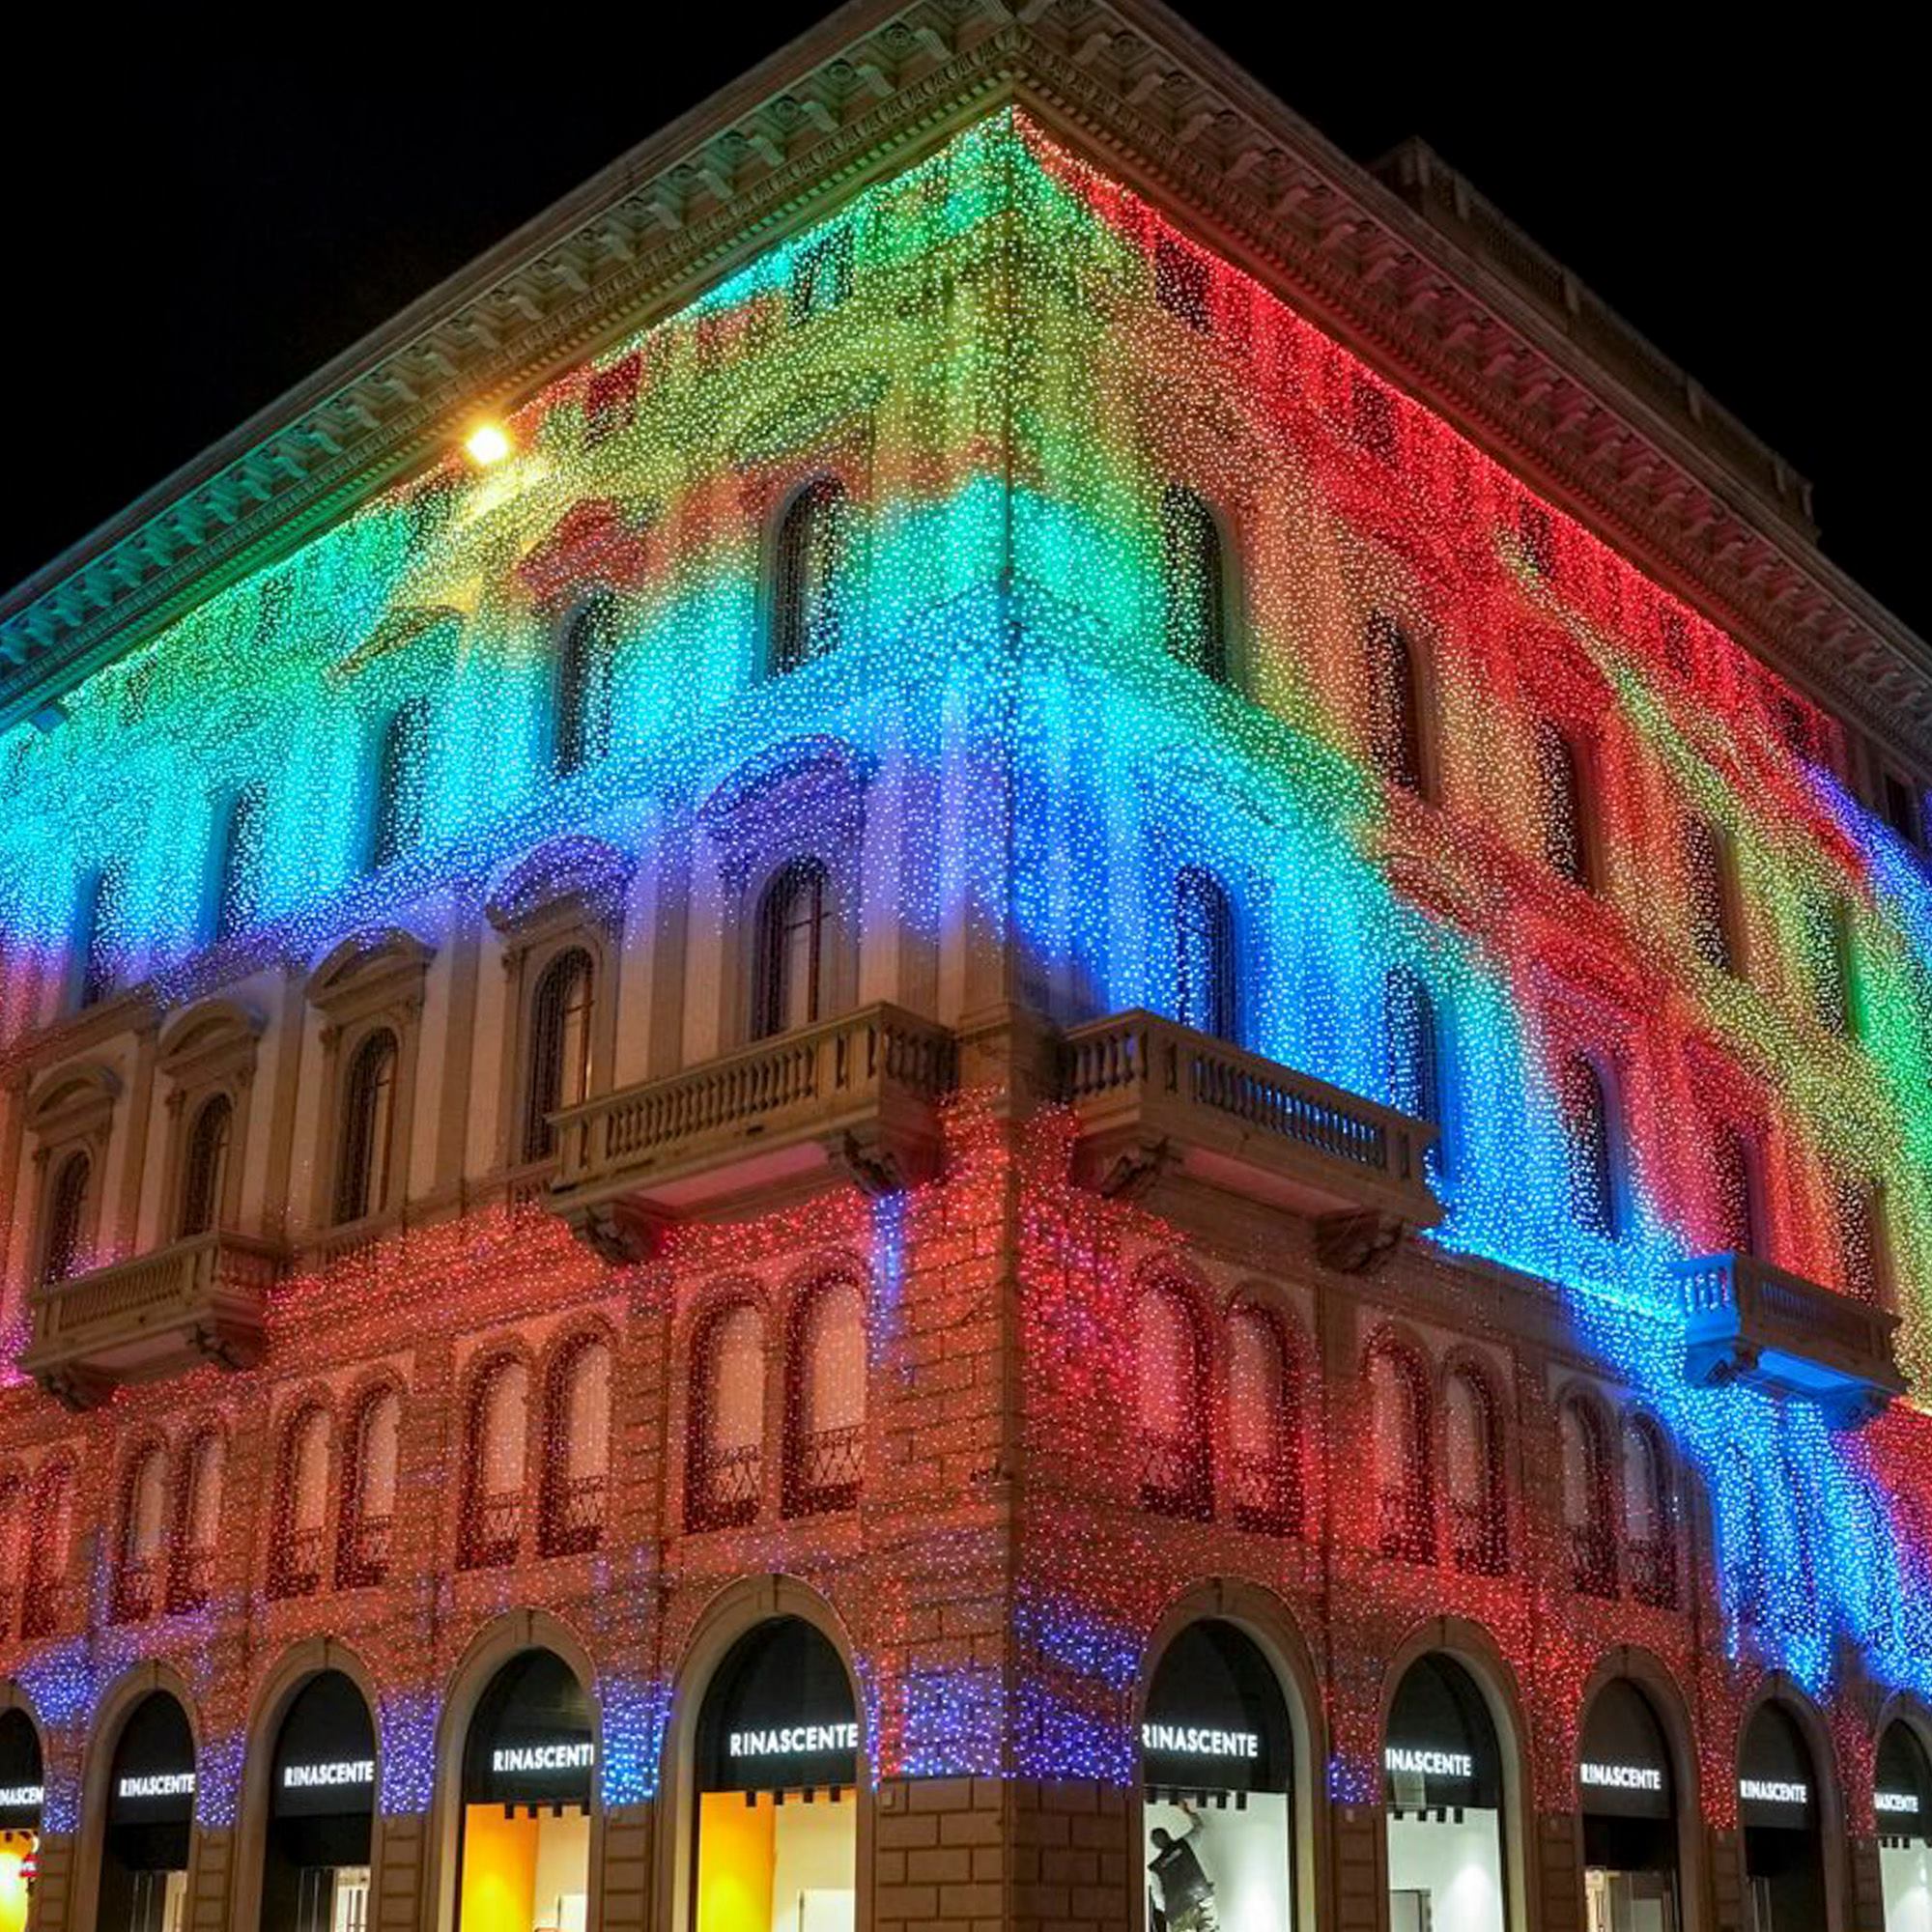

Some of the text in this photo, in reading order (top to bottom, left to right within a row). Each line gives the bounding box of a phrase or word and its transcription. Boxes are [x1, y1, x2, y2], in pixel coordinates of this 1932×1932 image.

[730, 1723, 859, 1757] RINASCENTE
[1142, 1724, 1258, 1757] RINASCENTE
[119, 1774, 196, 1797] RINASCENTE
[284, 1760, 375, 1787] RINASCENTE
[1580, 1764, 1662, 1789] RINASCENTE
[1740, 1779, 1807, 1804] RINASCENTE
